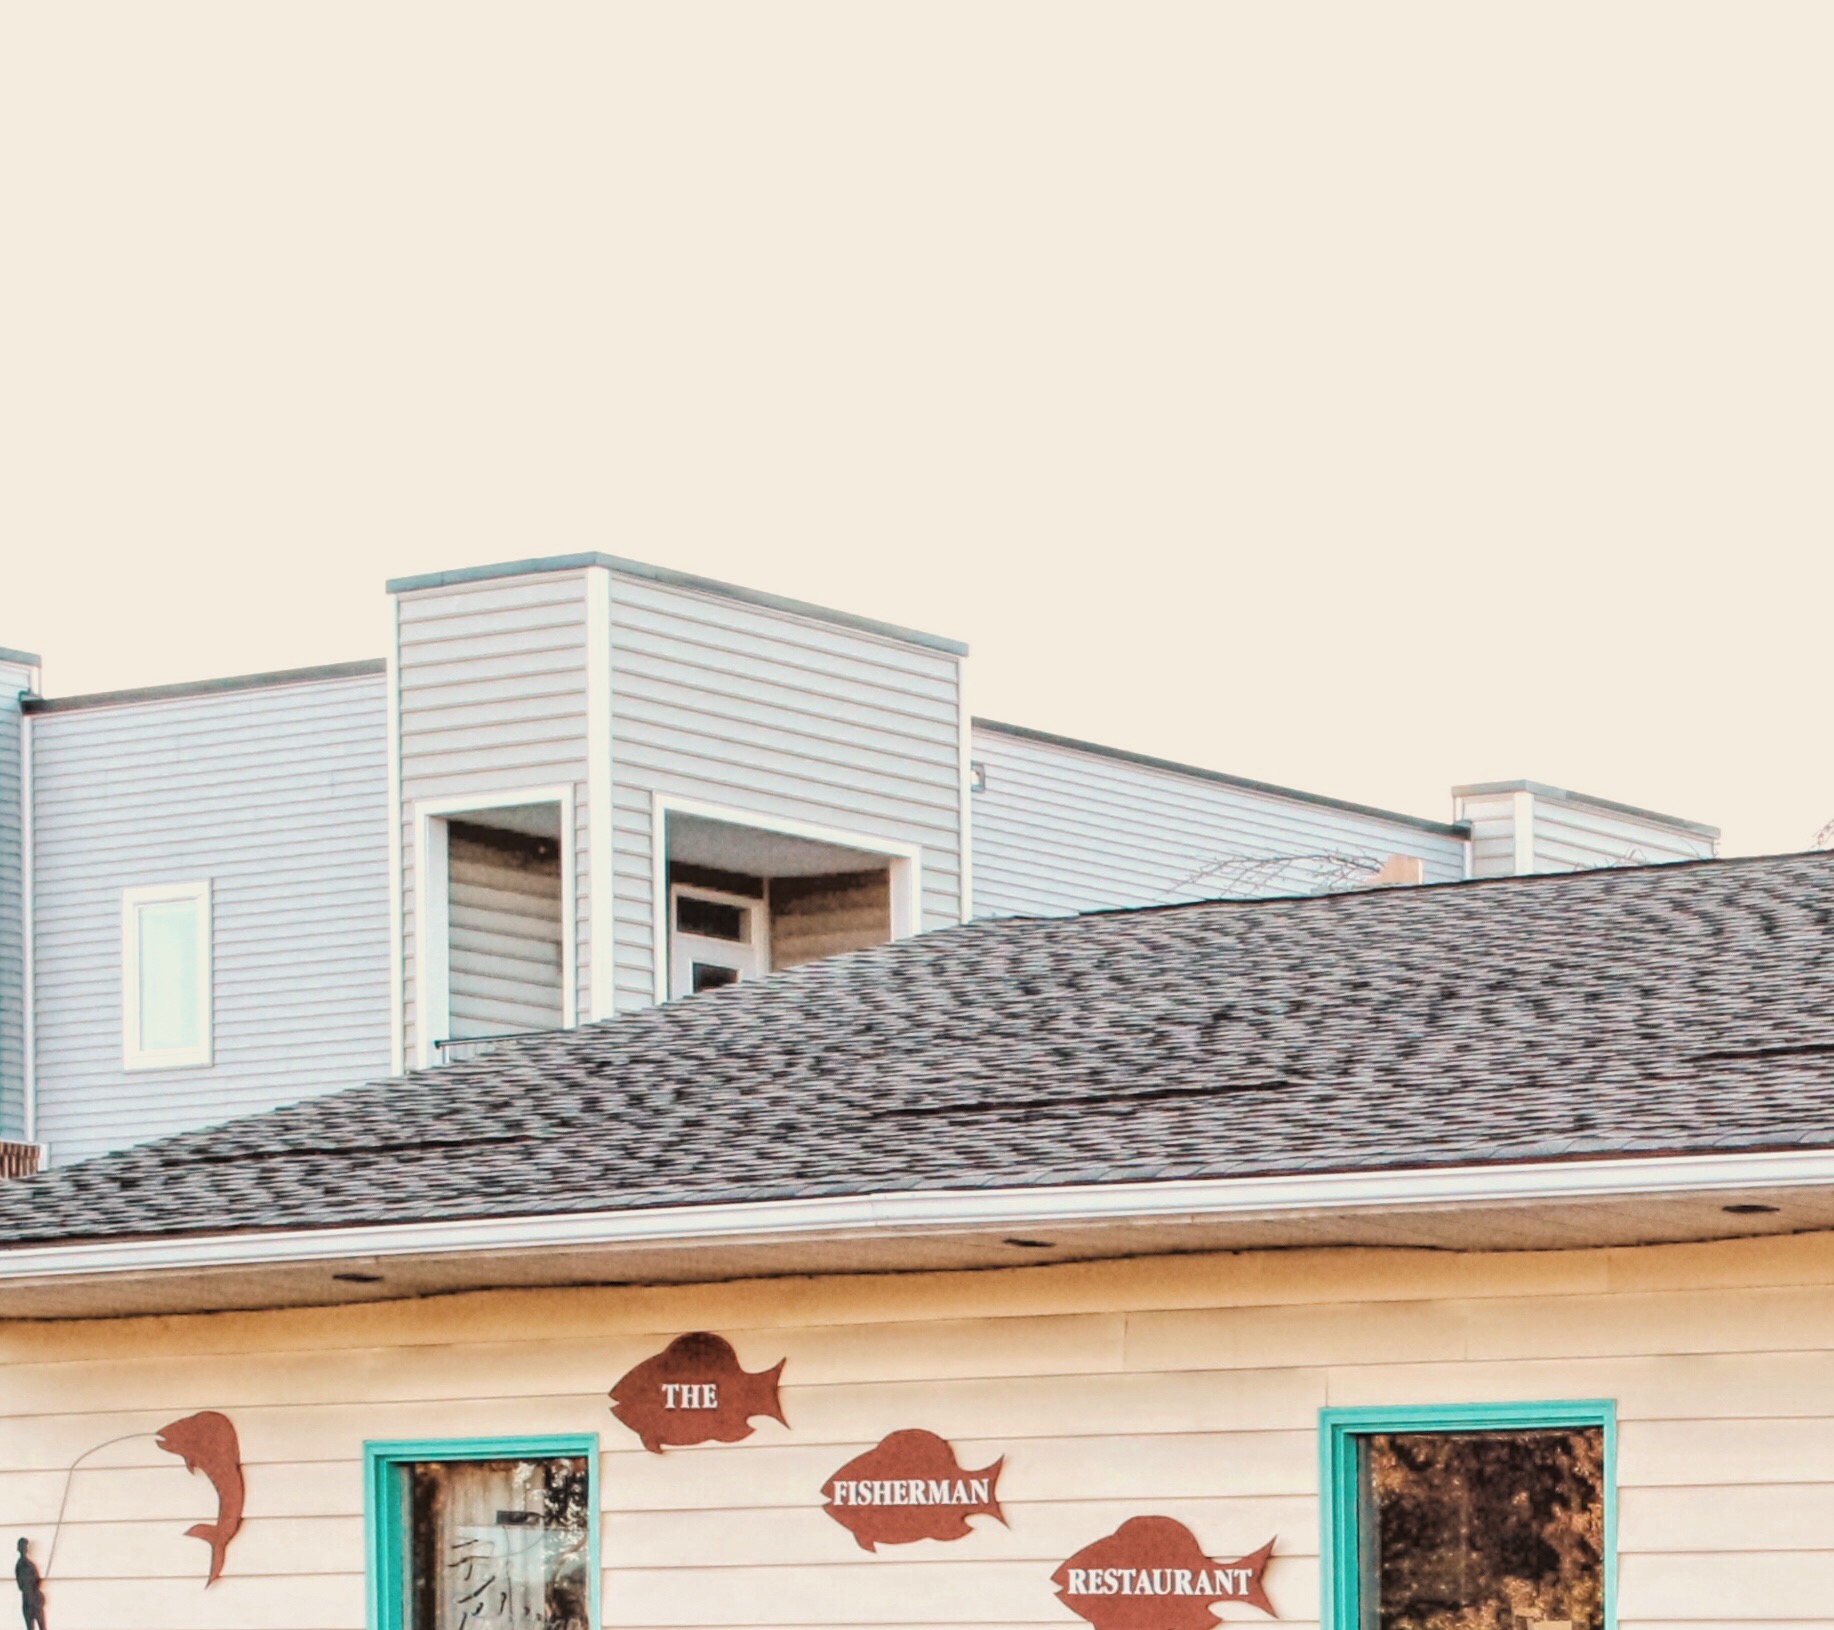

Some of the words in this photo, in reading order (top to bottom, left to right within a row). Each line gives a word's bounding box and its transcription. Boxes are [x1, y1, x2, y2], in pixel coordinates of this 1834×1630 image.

[661, 1383, 718, 1409] THE
[833, 1478, 989, 1506] FISHERMAN
[1067, 1568, 1252, 1595] RESTAURANT
